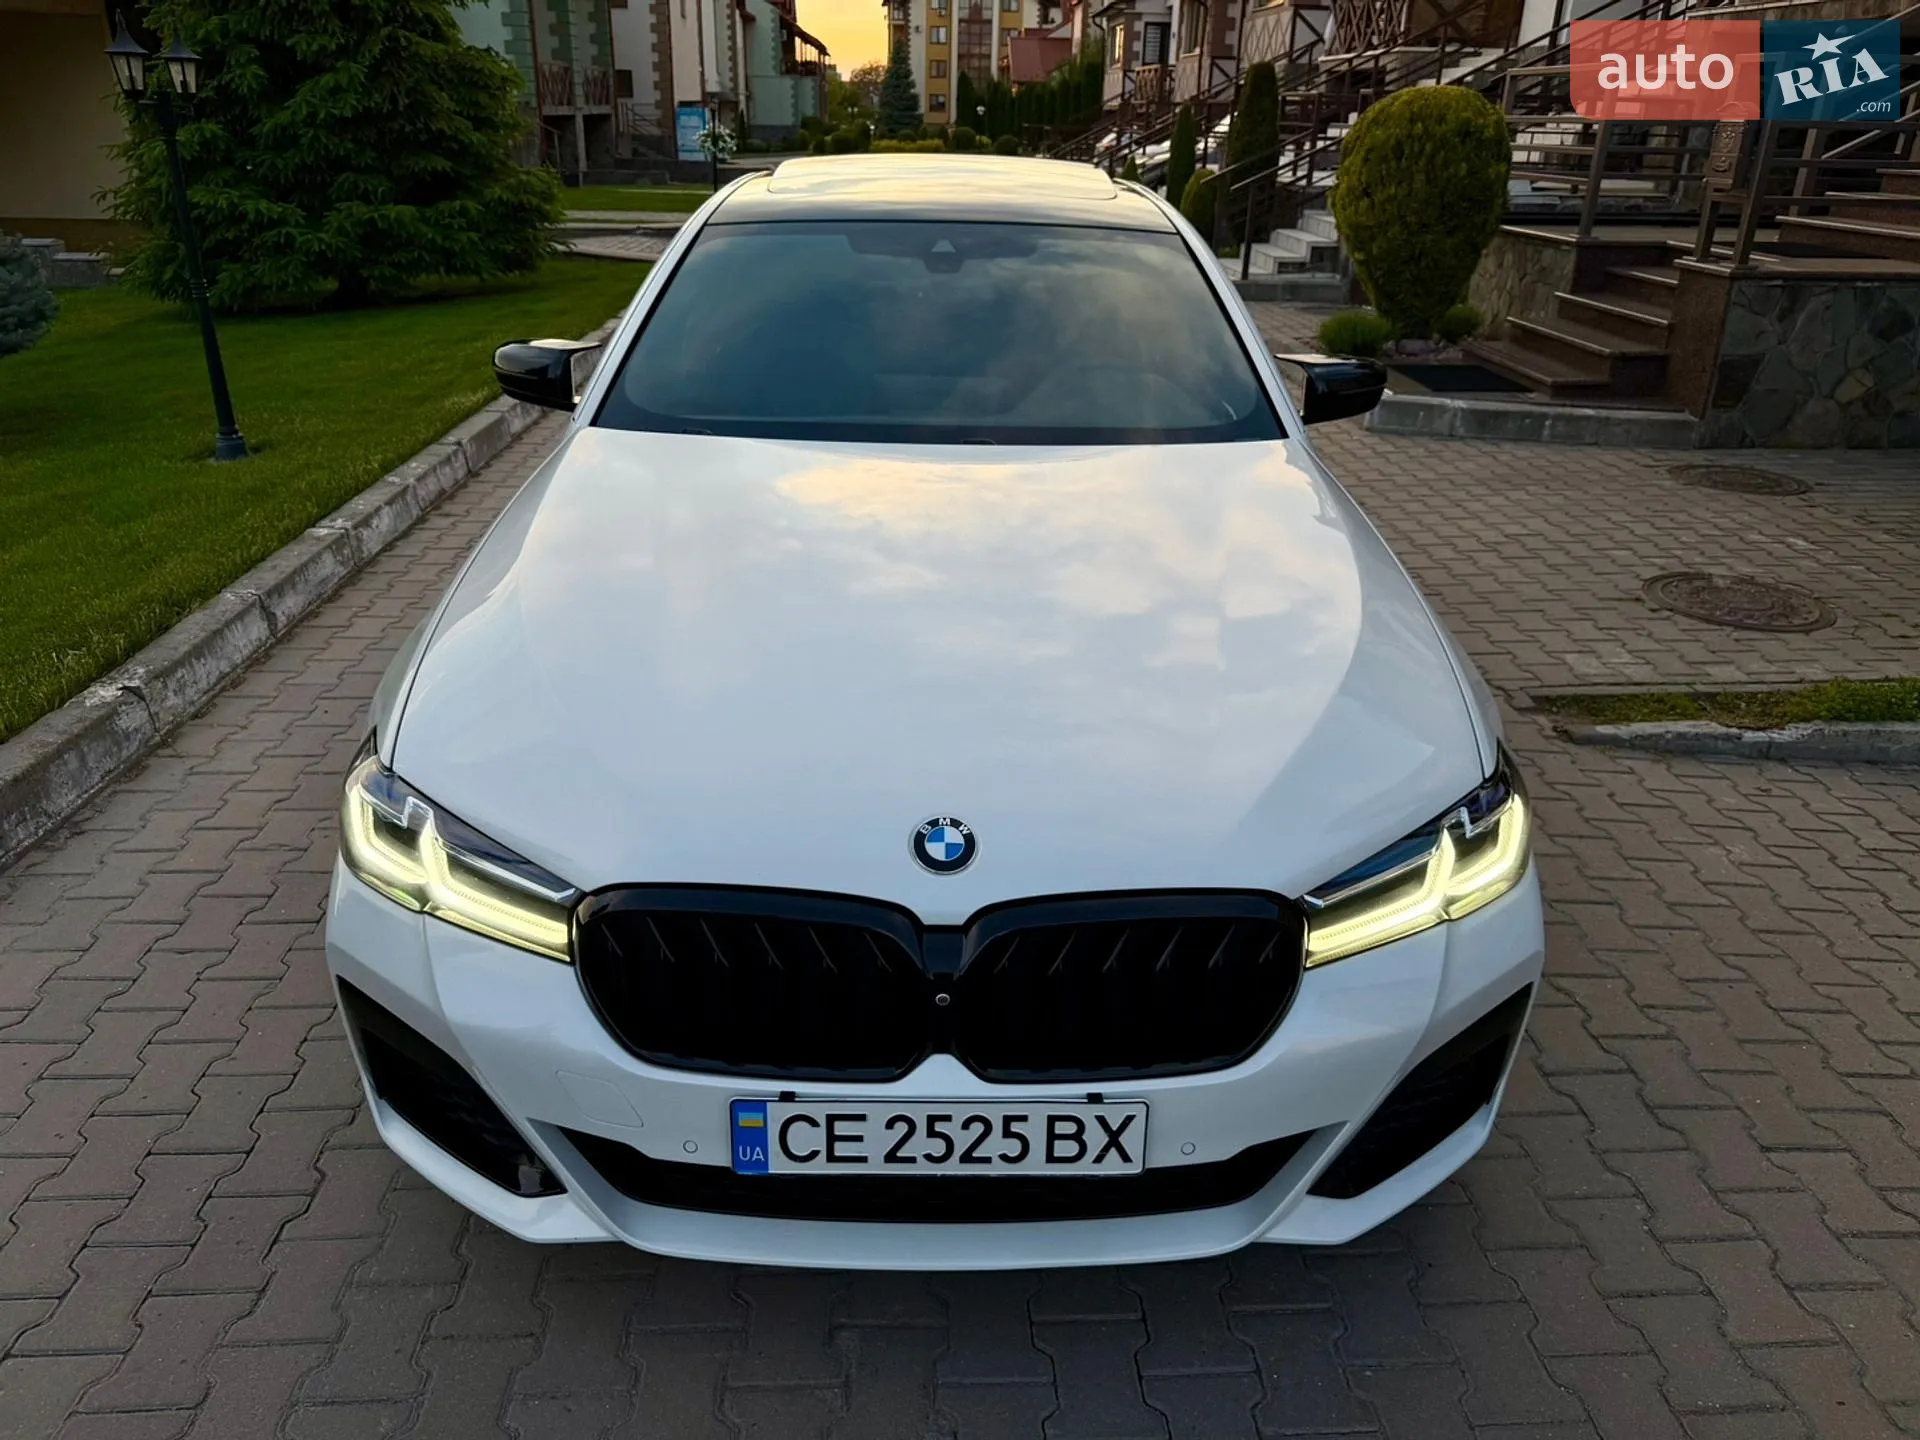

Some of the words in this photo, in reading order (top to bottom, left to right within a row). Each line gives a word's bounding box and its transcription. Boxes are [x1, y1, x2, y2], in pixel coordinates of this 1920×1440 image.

[920, 817, 972, 835] BMW
[778, 1113, 869, 1164] CE
[883, 1114, 1031, 1165] 2525
[1045, 1114, 1137, 1165] BX
[738, 1145, 766, 1162] UA
